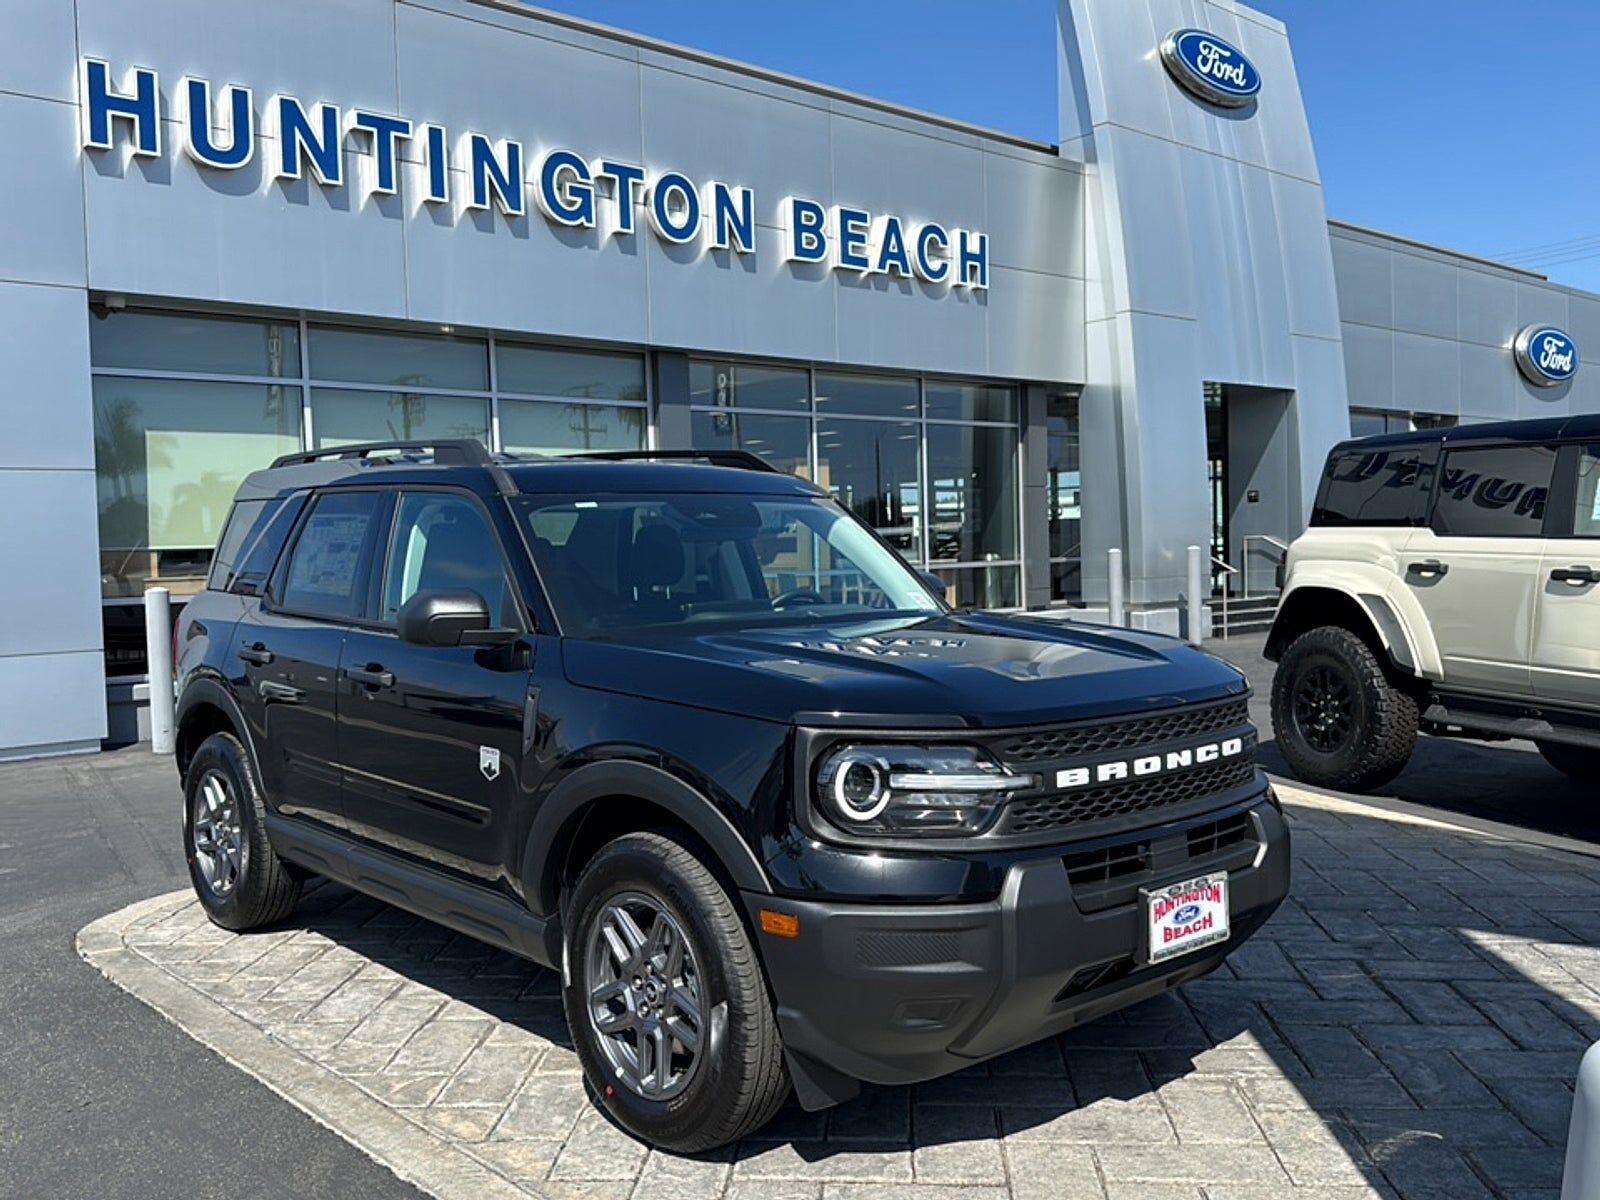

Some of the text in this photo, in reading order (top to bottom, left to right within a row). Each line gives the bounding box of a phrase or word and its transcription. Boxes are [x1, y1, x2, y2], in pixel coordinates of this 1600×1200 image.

[1197, 41, 1247, 87] Ford
[83, 58, 990, 290] HUNTINGTON BEACH
[1540, 337, 1573, 372] Ford
[1056, 738, 1242, 788] BRONCO
[1153, 883, 1221, 924] HUNTINGTON
[1163, 911, 1213, 943] BEACH
